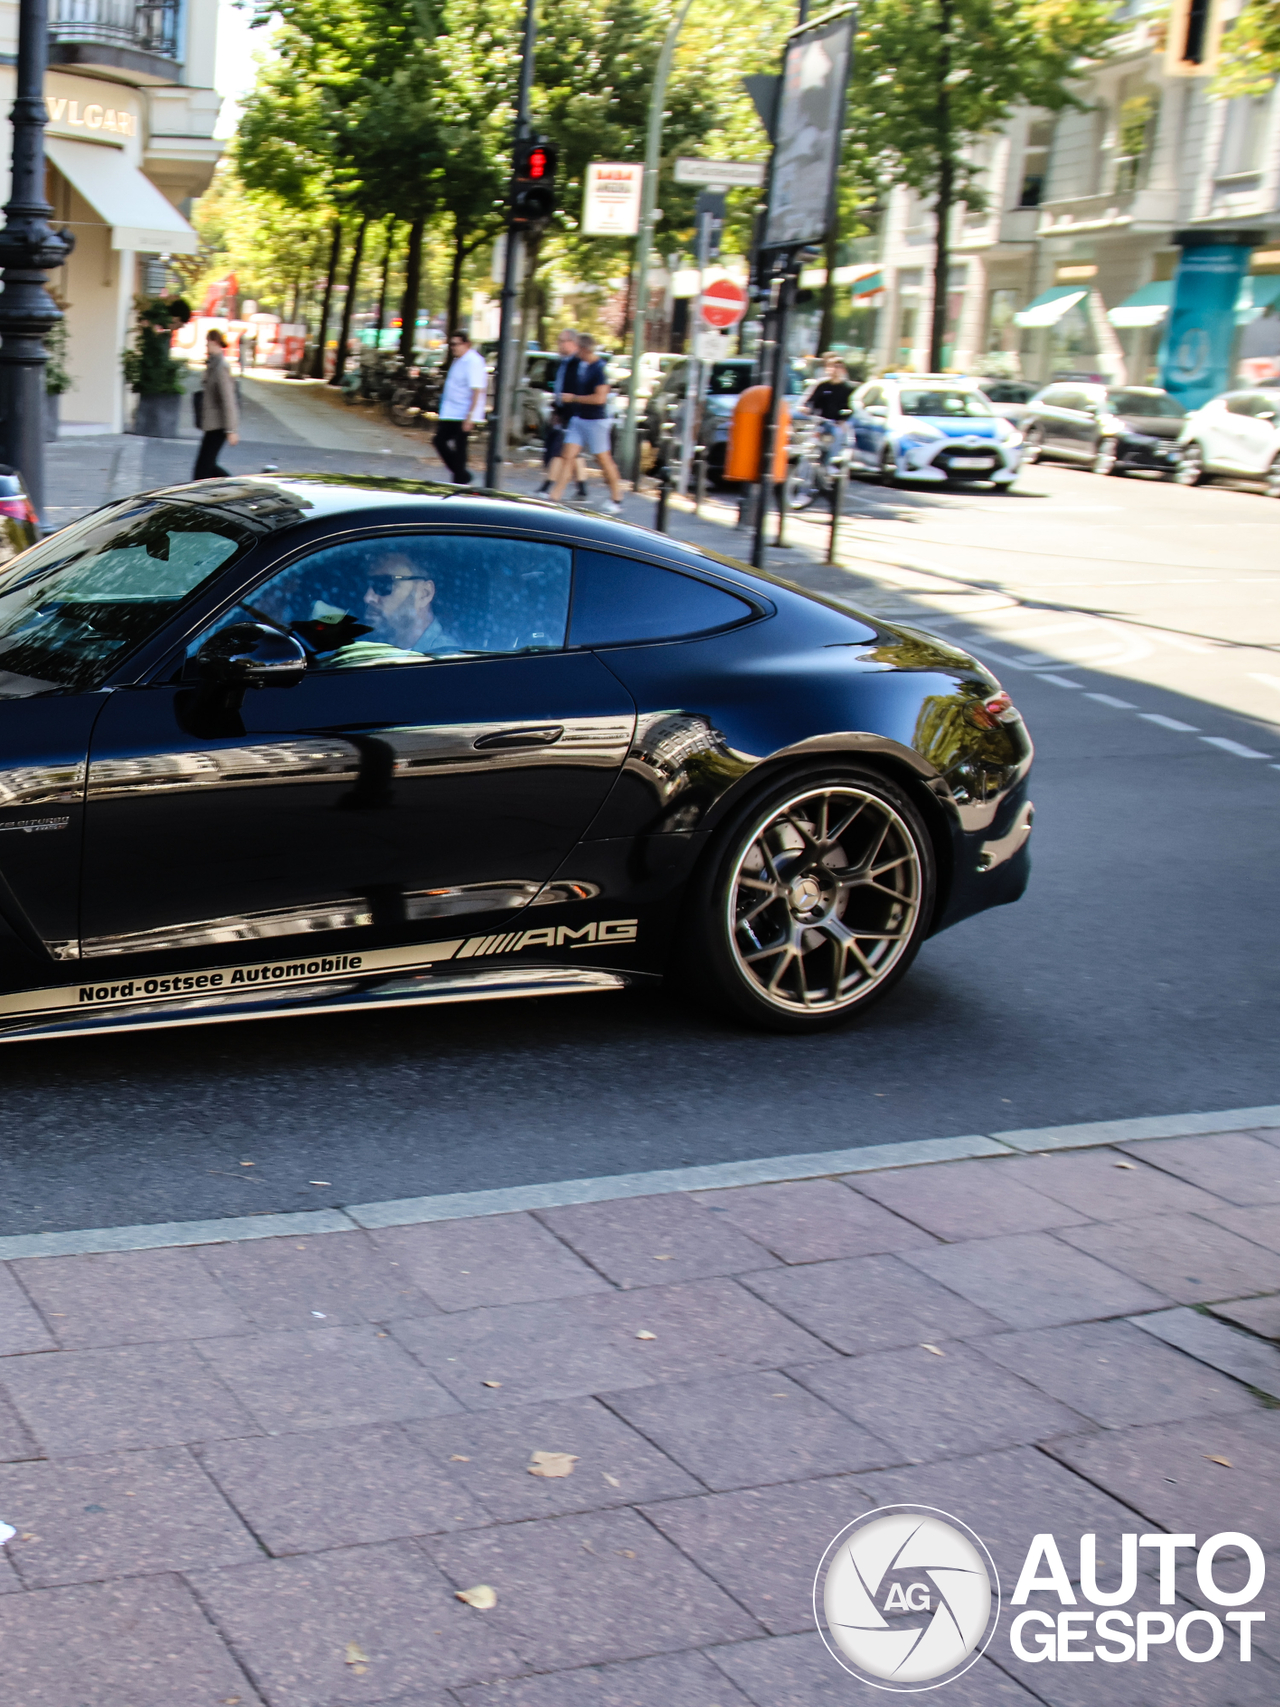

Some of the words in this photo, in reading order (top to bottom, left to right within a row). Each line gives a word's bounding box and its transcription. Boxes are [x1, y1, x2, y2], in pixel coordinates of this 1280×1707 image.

[45, 96, 137, 136] VLGARI
[513, 919, 639, 951] AMG
[79, 972, 223, 1002] Nord-Ostsee
[230, 955, 363, 984] Automobile
